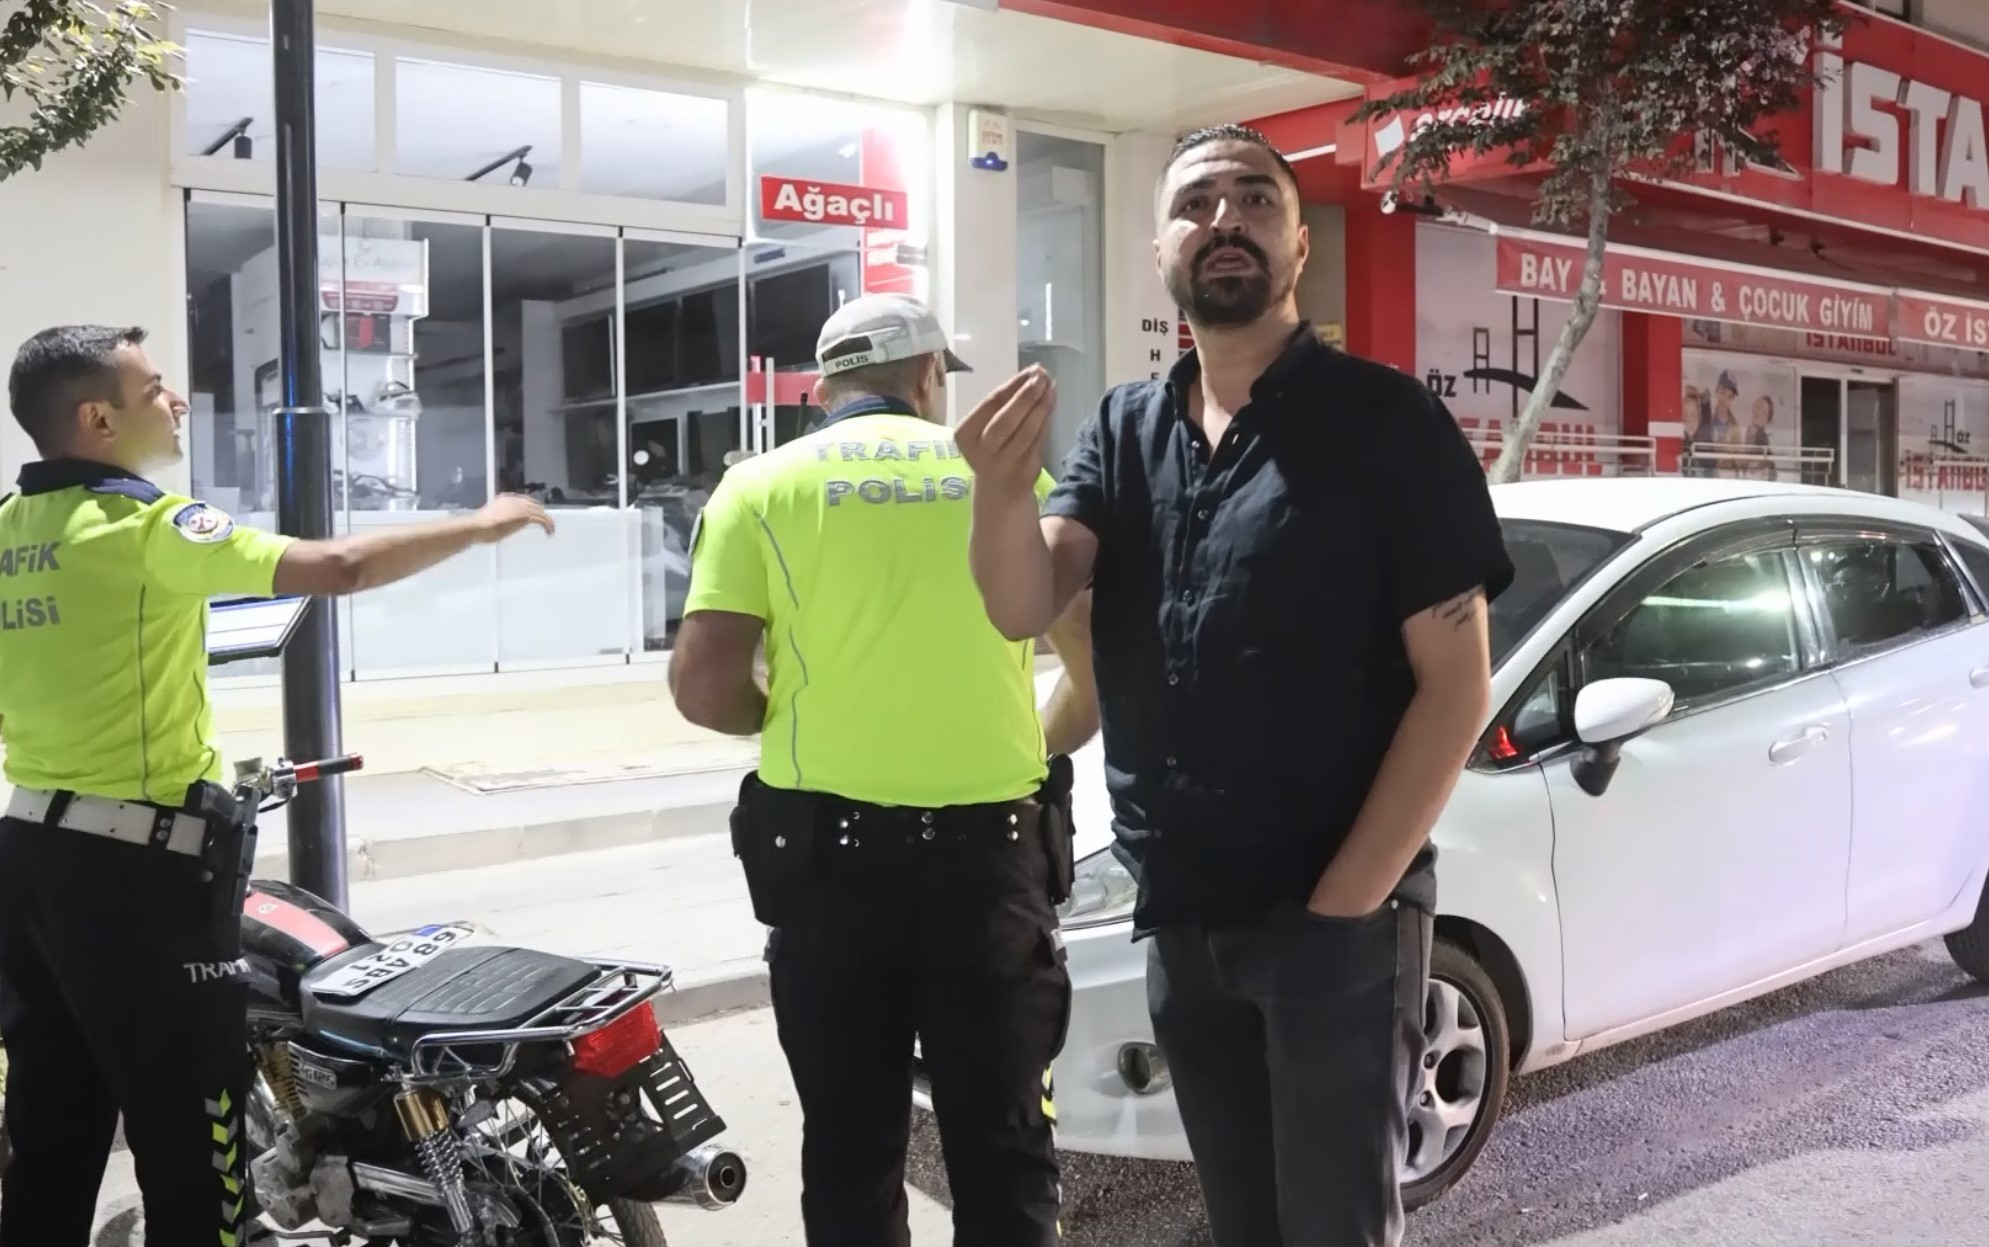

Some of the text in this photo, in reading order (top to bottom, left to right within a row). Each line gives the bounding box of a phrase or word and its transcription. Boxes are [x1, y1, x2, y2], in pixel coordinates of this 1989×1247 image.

[773, 183, 895, 225] Ağaçlı
[1520, 252, 1572, 293] BAY
[1621, 268, 1697, 310] BAYAN
[1710, 281, 1726, 313] &
[1739, 285, 1810, 321] ÇOCUK
[1819, 293, 1873, 331] GİYİM
[1142, 317, 1169, 336] DİŞ
[1924, 304, 1989, 345] ÖZ İS
[1426, 368, 1457, 397] ÖZ
